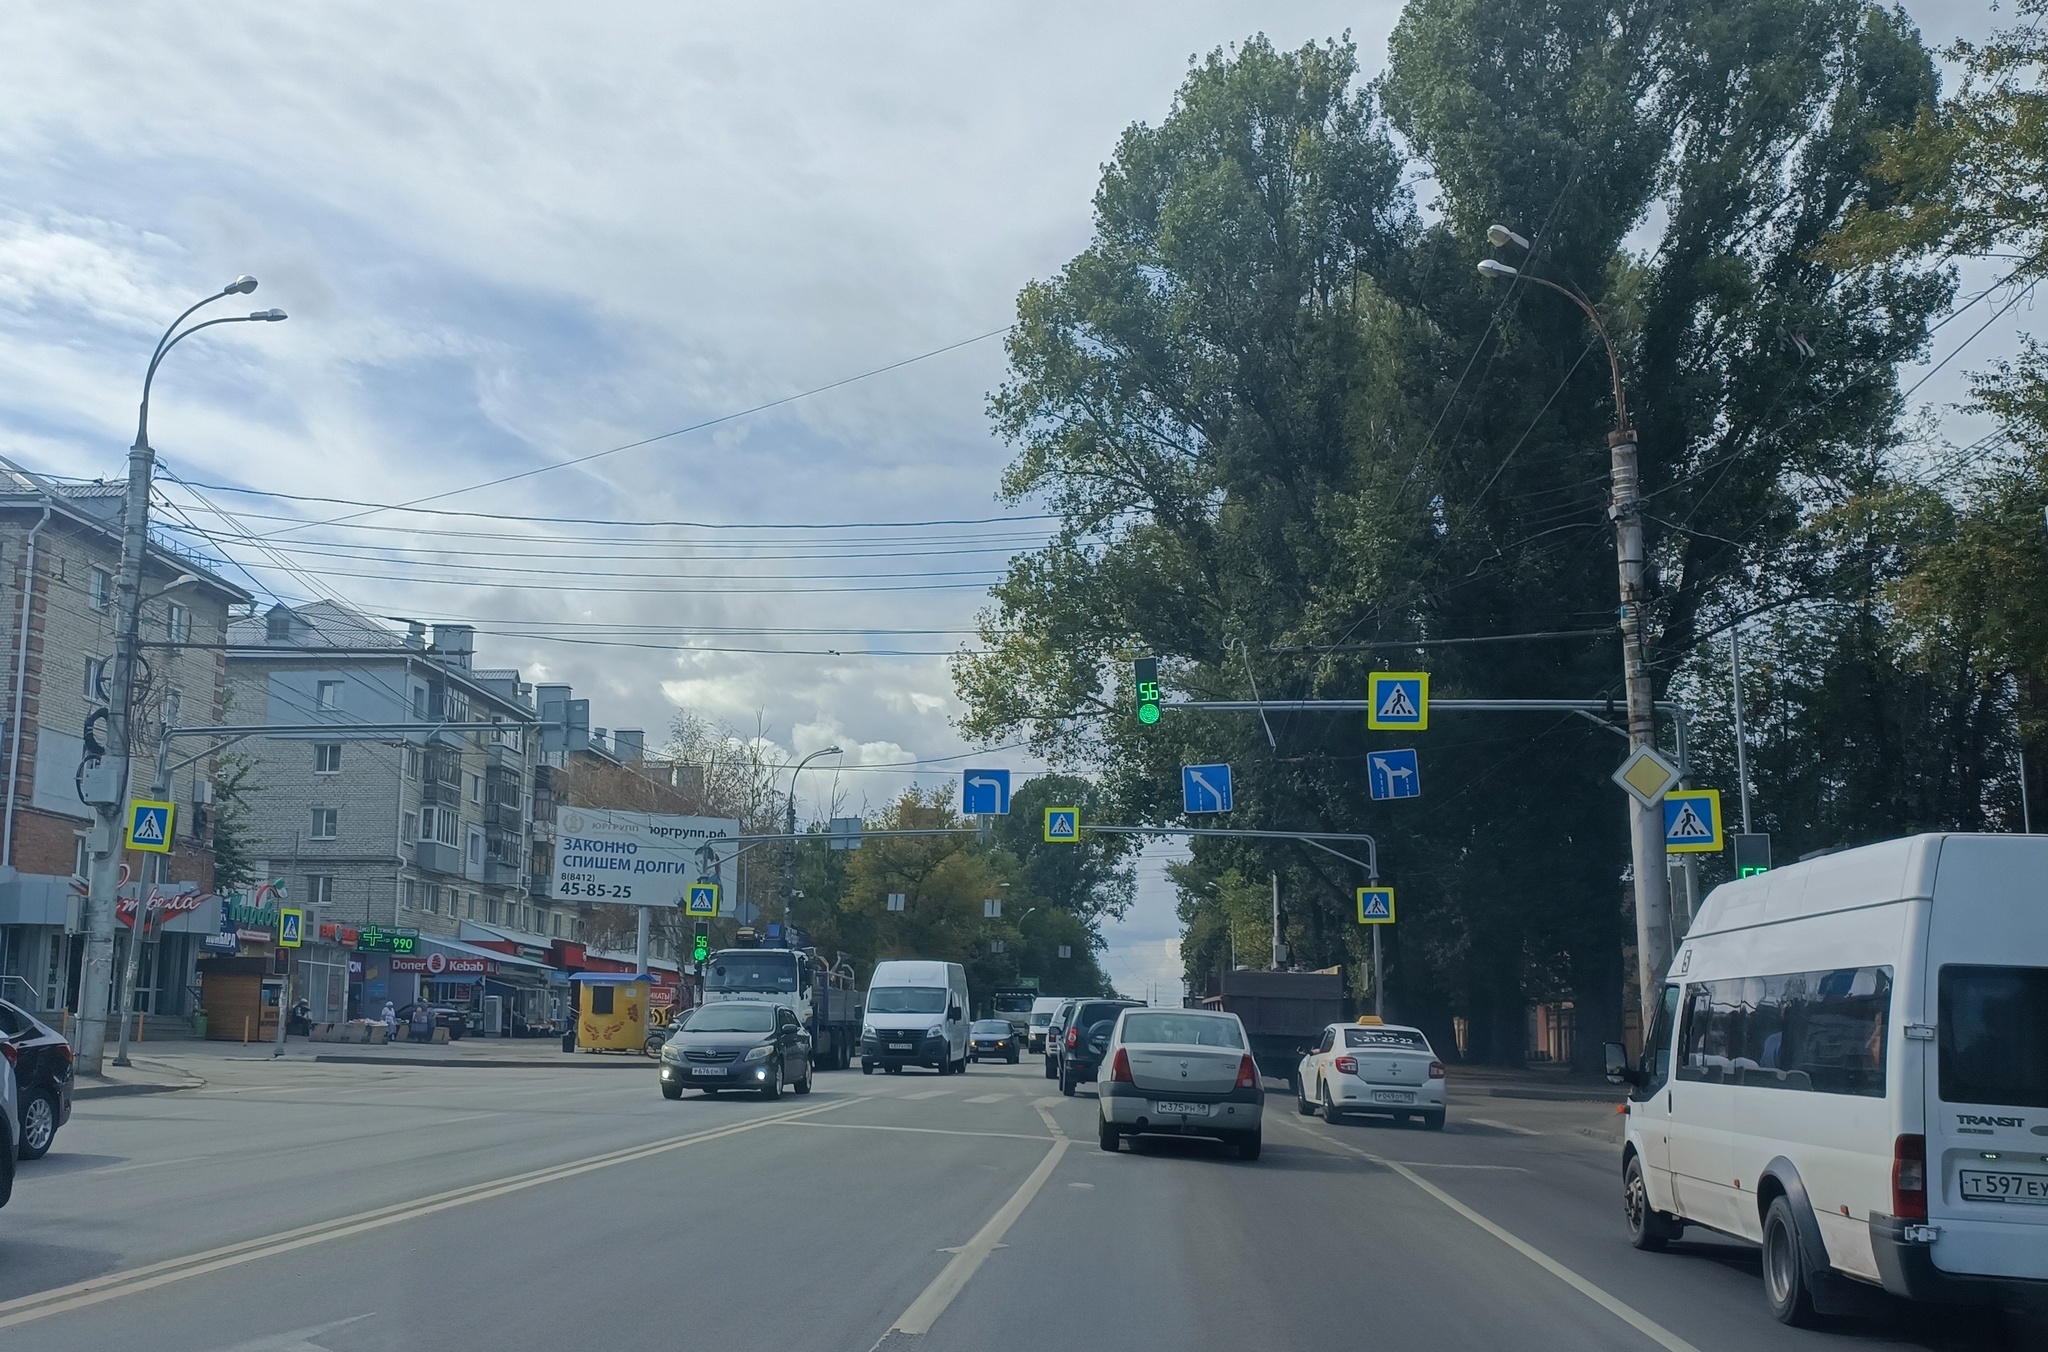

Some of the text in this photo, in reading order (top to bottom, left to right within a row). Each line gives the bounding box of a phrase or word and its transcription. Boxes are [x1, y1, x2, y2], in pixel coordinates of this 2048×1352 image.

[1140, 682, 1158, 700] 56
[592, 822, 639, 832] ЮРГРУПП
[563, 838, 638, 854] ЗАКОННО
[562, 855, 685, 874] СПИШЕМ ДОЛГИ
[561, 872, 595, 882] 8(8412)
[560, 882, 632, 898] 45-85-25
[393, 938, 413, 949] 990
[697, 936, 707, 947] 56
[393, 960, 484, 972] Doner Kebab
[1957, 1115, 2025, 1128] TRANSIT
